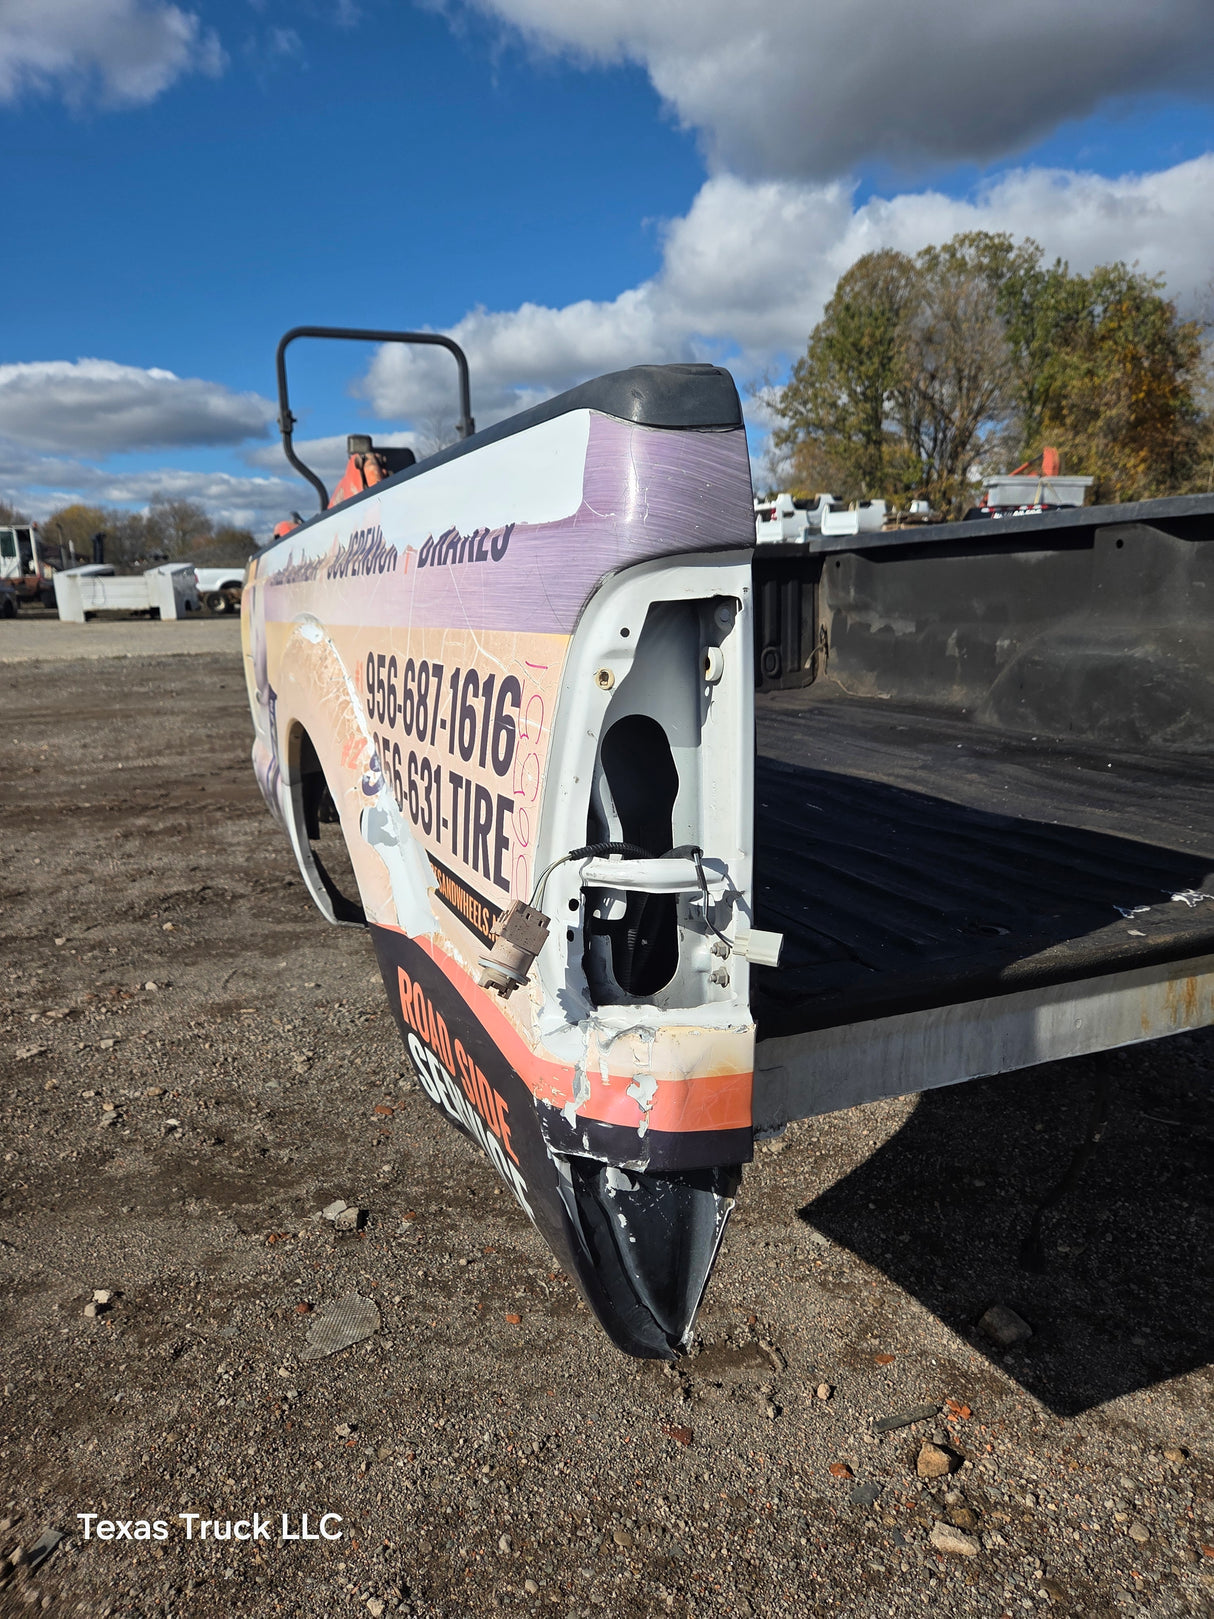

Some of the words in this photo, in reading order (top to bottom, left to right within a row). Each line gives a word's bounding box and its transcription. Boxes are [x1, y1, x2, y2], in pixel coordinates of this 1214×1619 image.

[366, 651, 522, 777] 956-687-1616
[397, 965, 457, 1078] ROAD
[454, 1037, 520, 1167] SIDE
